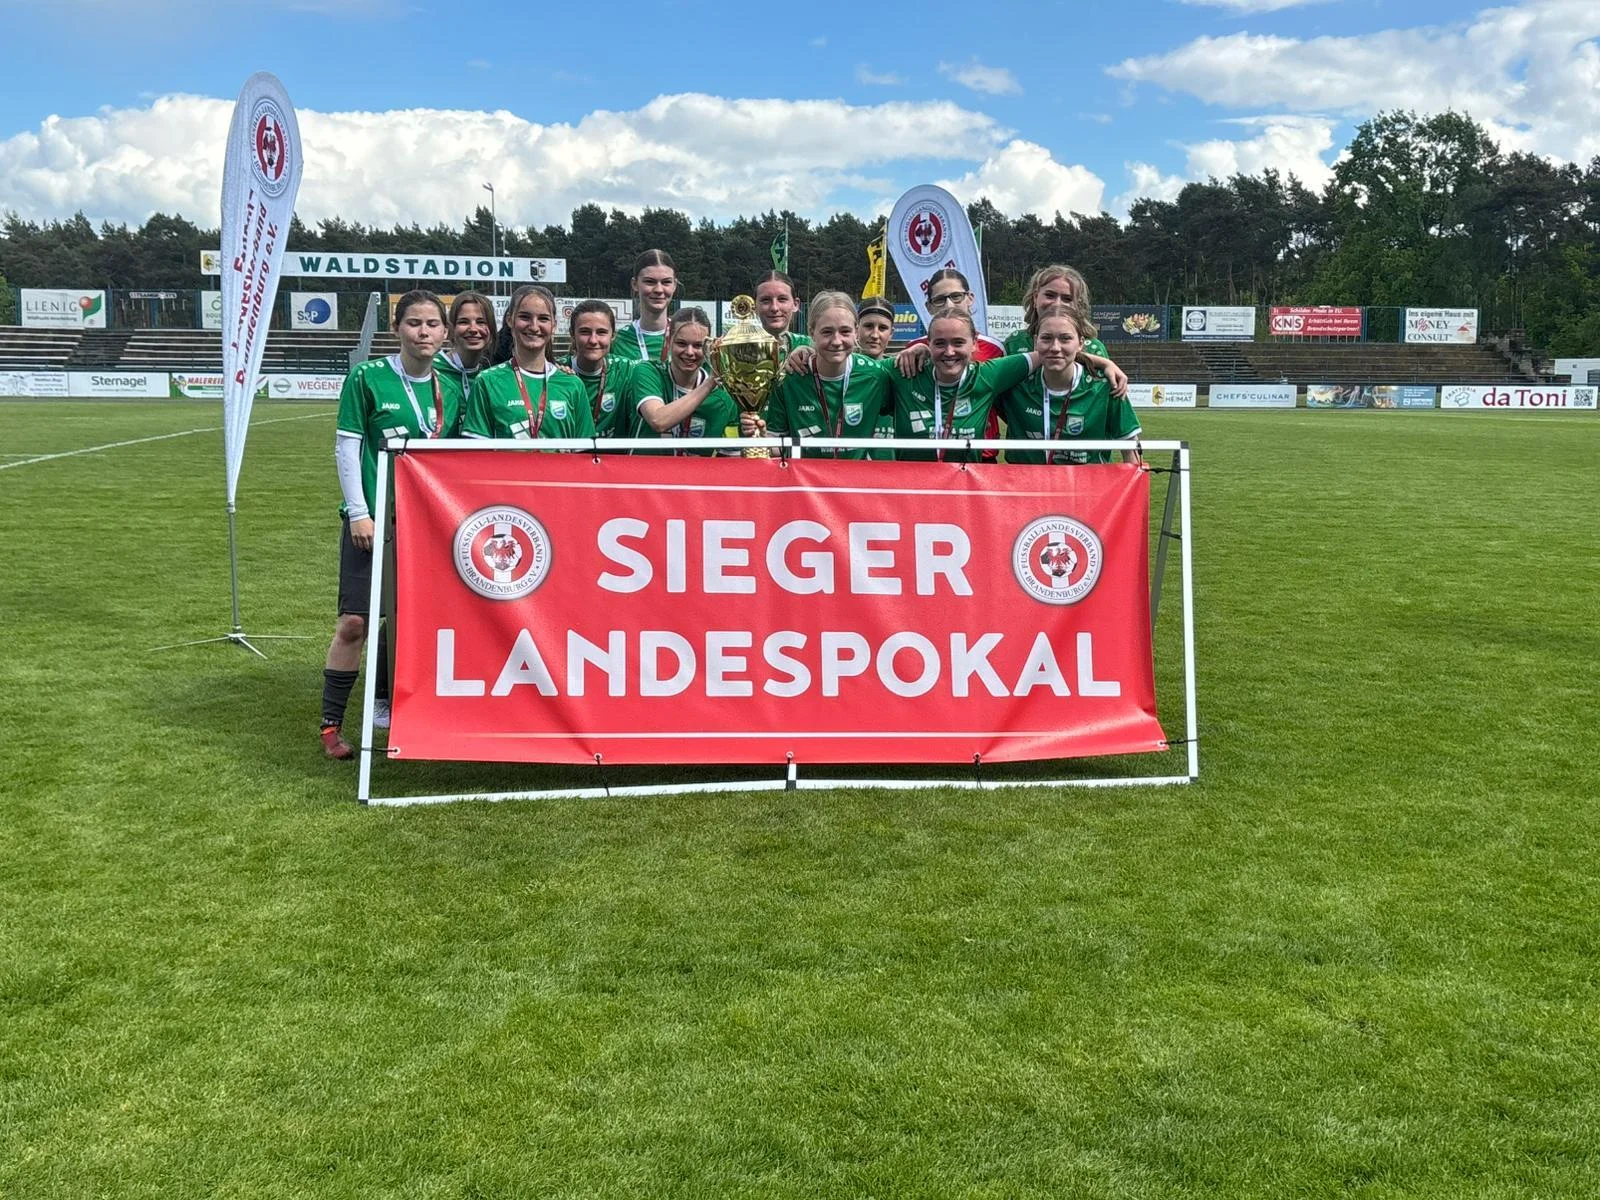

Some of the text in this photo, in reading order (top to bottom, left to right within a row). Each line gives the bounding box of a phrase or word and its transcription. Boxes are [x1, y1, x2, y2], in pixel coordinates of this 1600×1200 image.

[299, 256, 514, 277] WALDSTADION
[26, 301, 77, 312] LIENIG
[297, 310, 319, 321] S&P
[1274, 318, 1302, 329] KNS
[1407, 333, 1450, 341] CONSULT
[91, 375, 148, 388] Sternagel
[1481, 387, 1567, 407] da Toni
[381, 402, 401, 410] JAKO
[798, 404, 816, 412] JAKO
[1025, 407, 1043, 416] JAKO
[596, 517, 974, 597] SIEGER
[435, 628, 1122, 698] LANDESPOKAL
